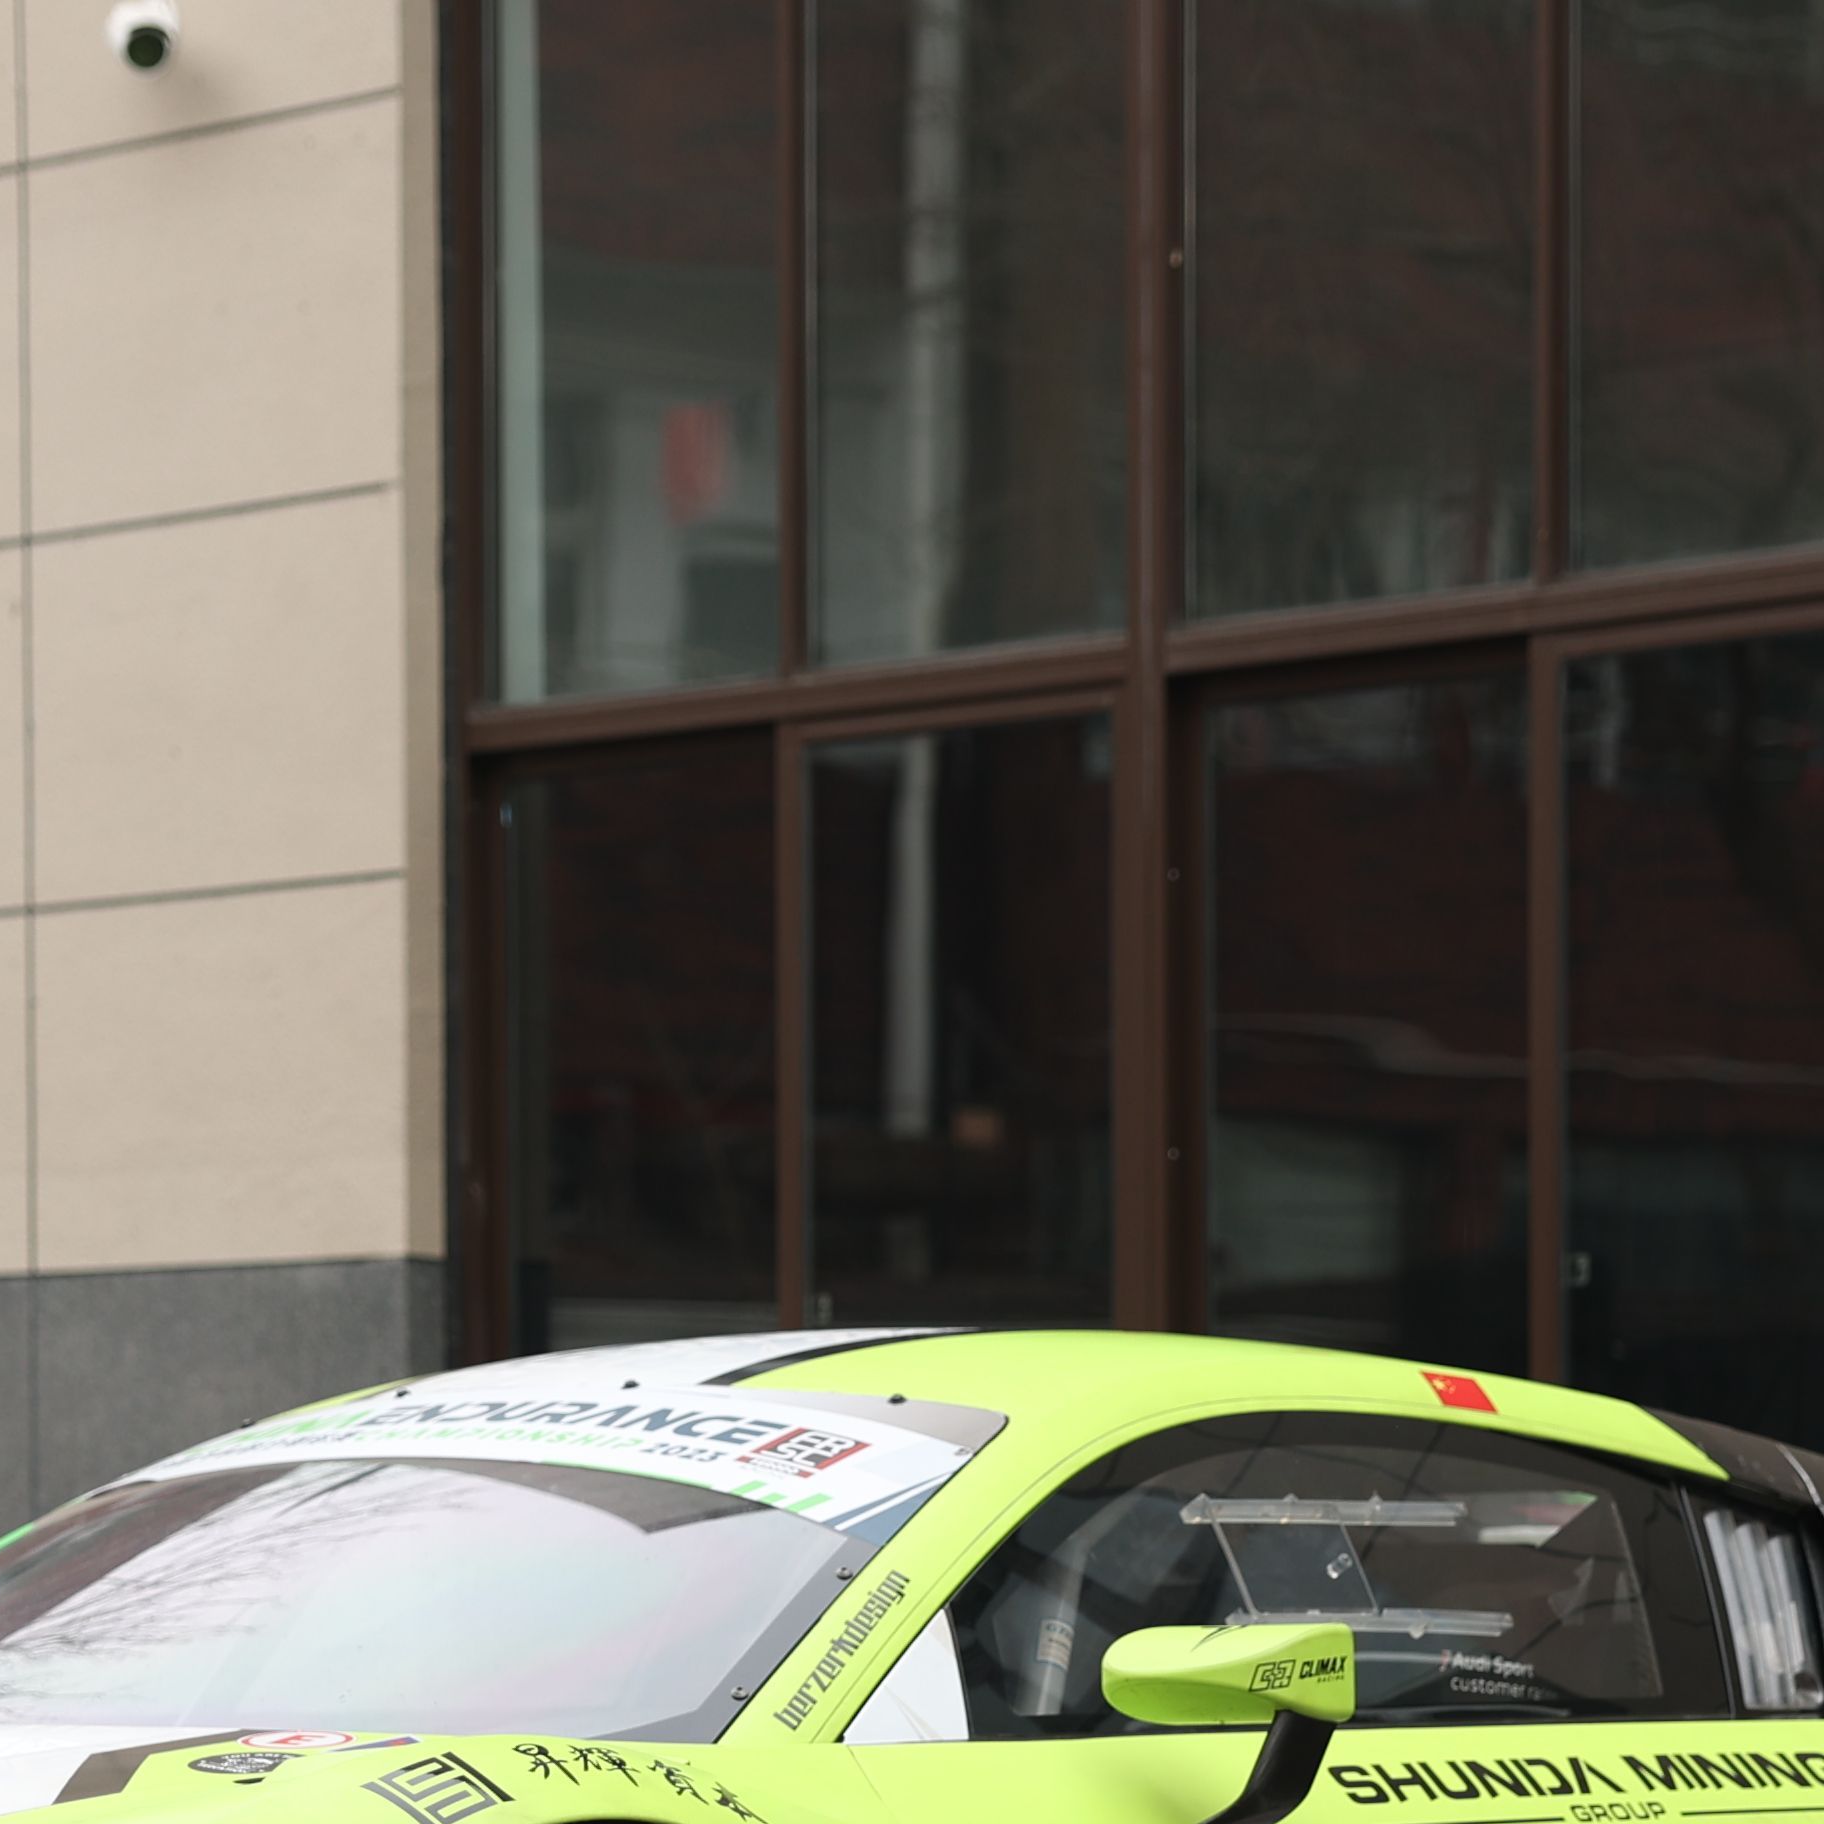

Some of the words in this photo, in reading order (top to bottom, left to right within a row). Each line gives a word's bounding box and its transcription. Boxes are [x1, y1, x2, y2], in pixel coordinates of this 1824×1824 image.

[356, 1401, 784, 1447] ENDURANCE
[642, 1440, 730, 1464] 2023
[773, 1570, 911, 1732] berzerkdesign
[1299, 1656, 1348, 1680] CLIMAX
[1451, 1652, 1491, 1673] Audi
[1493, 1655, 1535, 1679] Sport
[1449, 1676, 1525, 1699] customer
[1328, 1757, 1623, 1804] SHUNDA
[1569, 1802, 1667, 1824] GROUP
